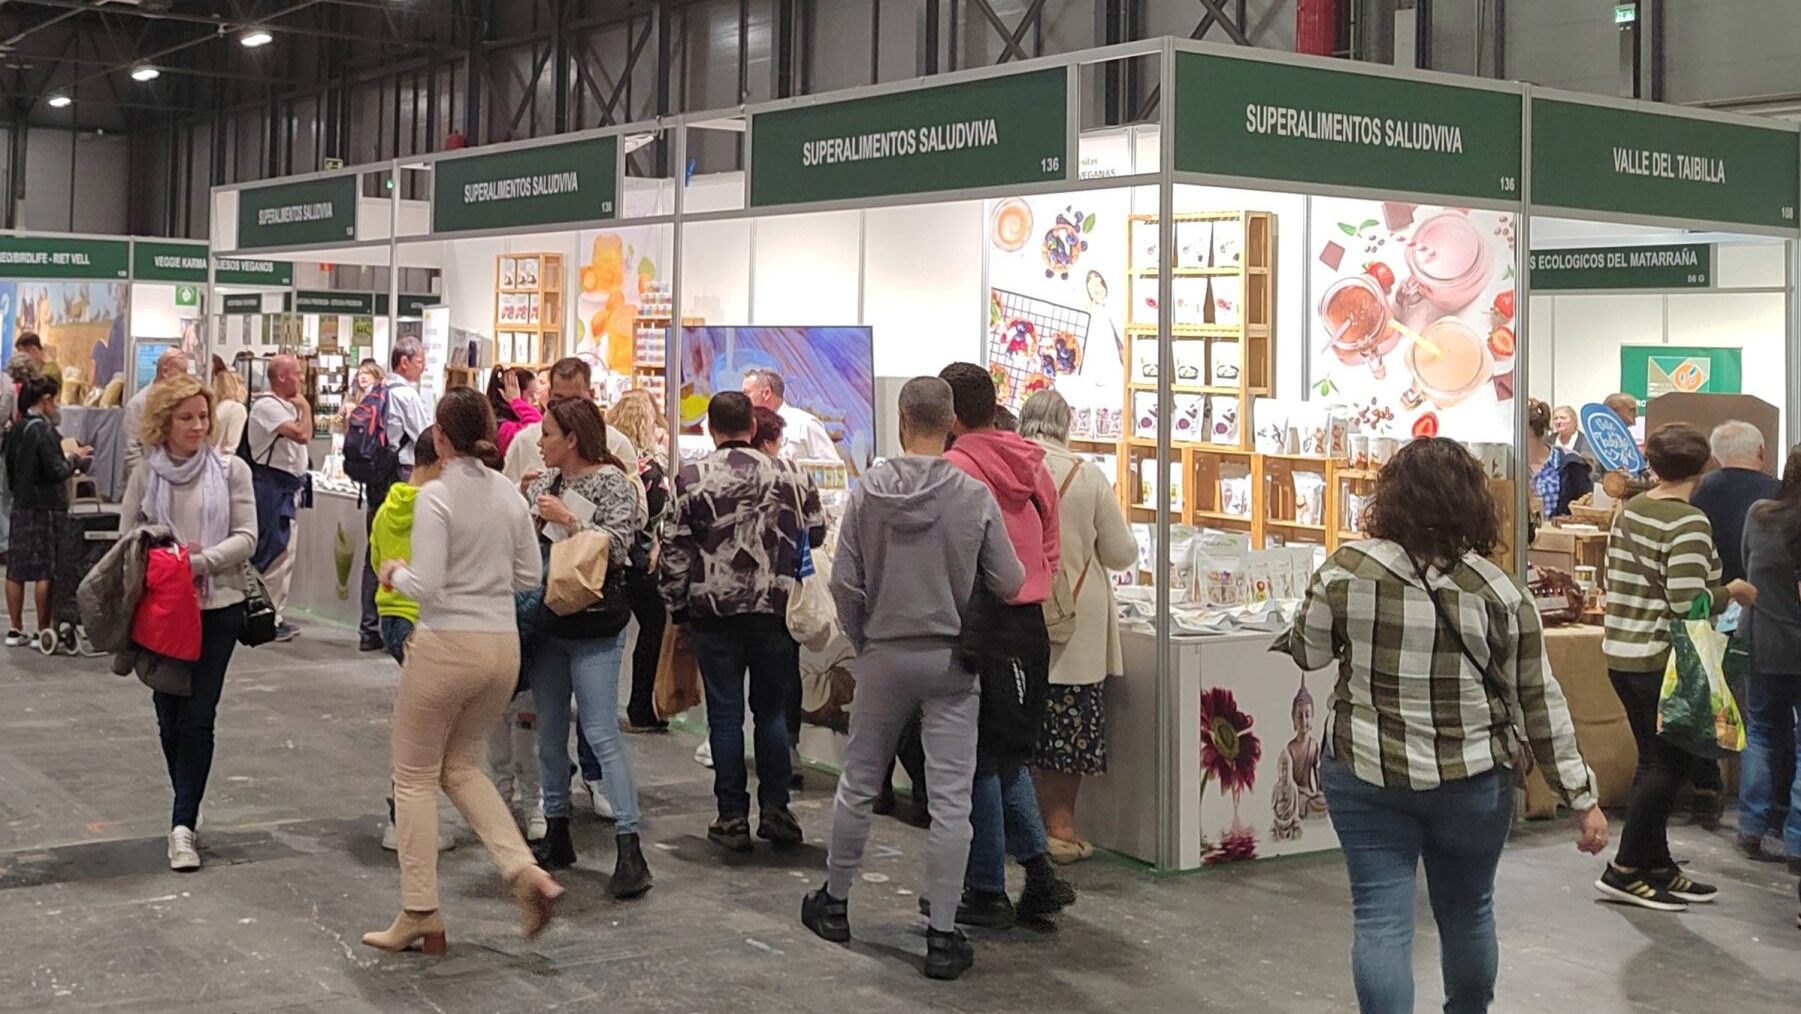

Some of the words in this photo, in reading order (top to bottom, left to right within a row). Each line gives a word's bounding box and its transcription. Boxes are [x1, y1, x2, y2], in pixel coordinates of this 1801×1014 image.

[1246, 104, 1381, 145] SUPERALIMENTOS
[1384, 119, 1463, 154] SALUDVIVA
[802, 128, 917, 167] SUPERALIMENTOS
[919, 119, 998, 153] SALUDVIVA
[1040, 157, 1060, 172] 136
[1613, 147, 1650, 175] VALLE
[1652, 152, 1675, 179] DEL
[1676, 155, 1726, 184] TAIBILLA
[464, 176, 531, 203] SUPERALIMENTOS
[532, 172, 578, 196] SALUDVIVA
[1500, 176, 1515, 192] 136
[154, 256, 181, 268] VEGGIE
[181, 258, 207, 269] KARMA
[241, 261, 274, 273] VEGANOS
[1538, 253, 1605, 270] ECOLOGICOS
[1607, 253, 1628, 268] DEL
[1629, 248, 1698, 267] MATARRAÑA
